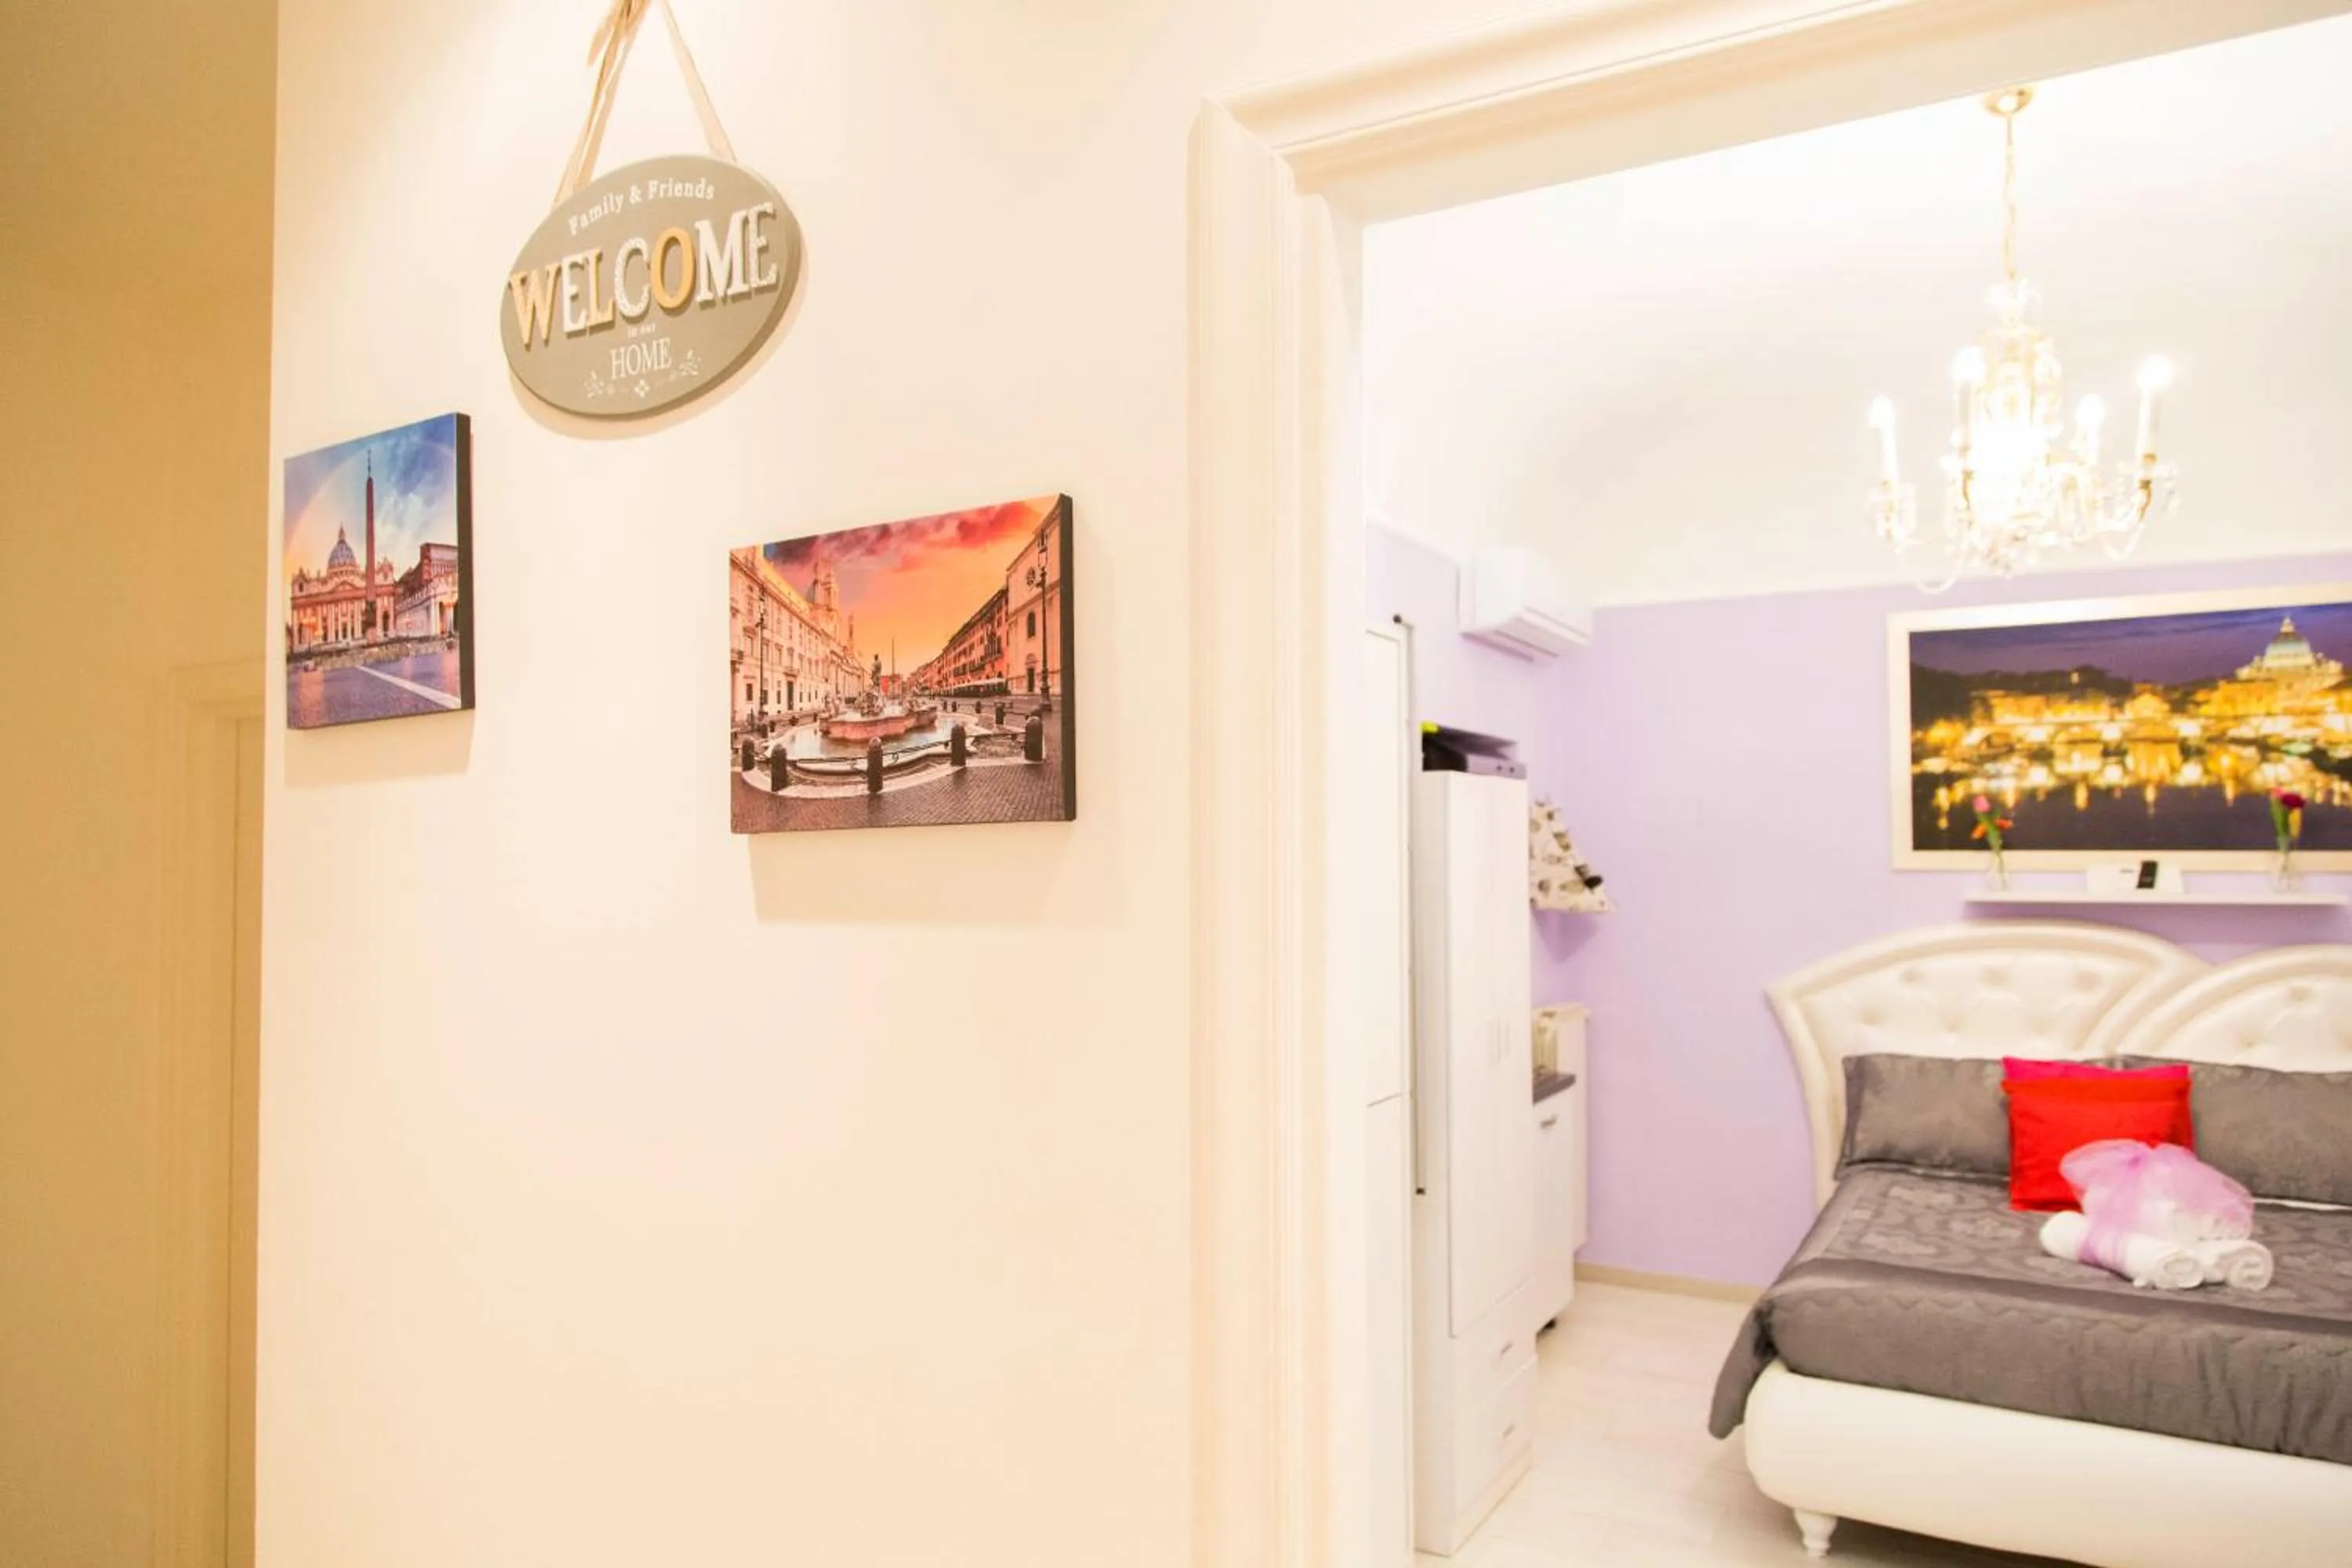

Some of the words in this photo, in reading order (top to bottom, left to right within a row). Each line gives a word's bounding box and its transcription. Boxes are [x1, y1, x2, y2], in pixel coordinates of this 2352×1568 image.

[568, 193, 624, 235] Family
[629, 184, 642, 204] &
[648, 178, 715, 200] Friends
[508, 201, 779, 350] WELCOME
[610, 338, 672, 379] HOME
